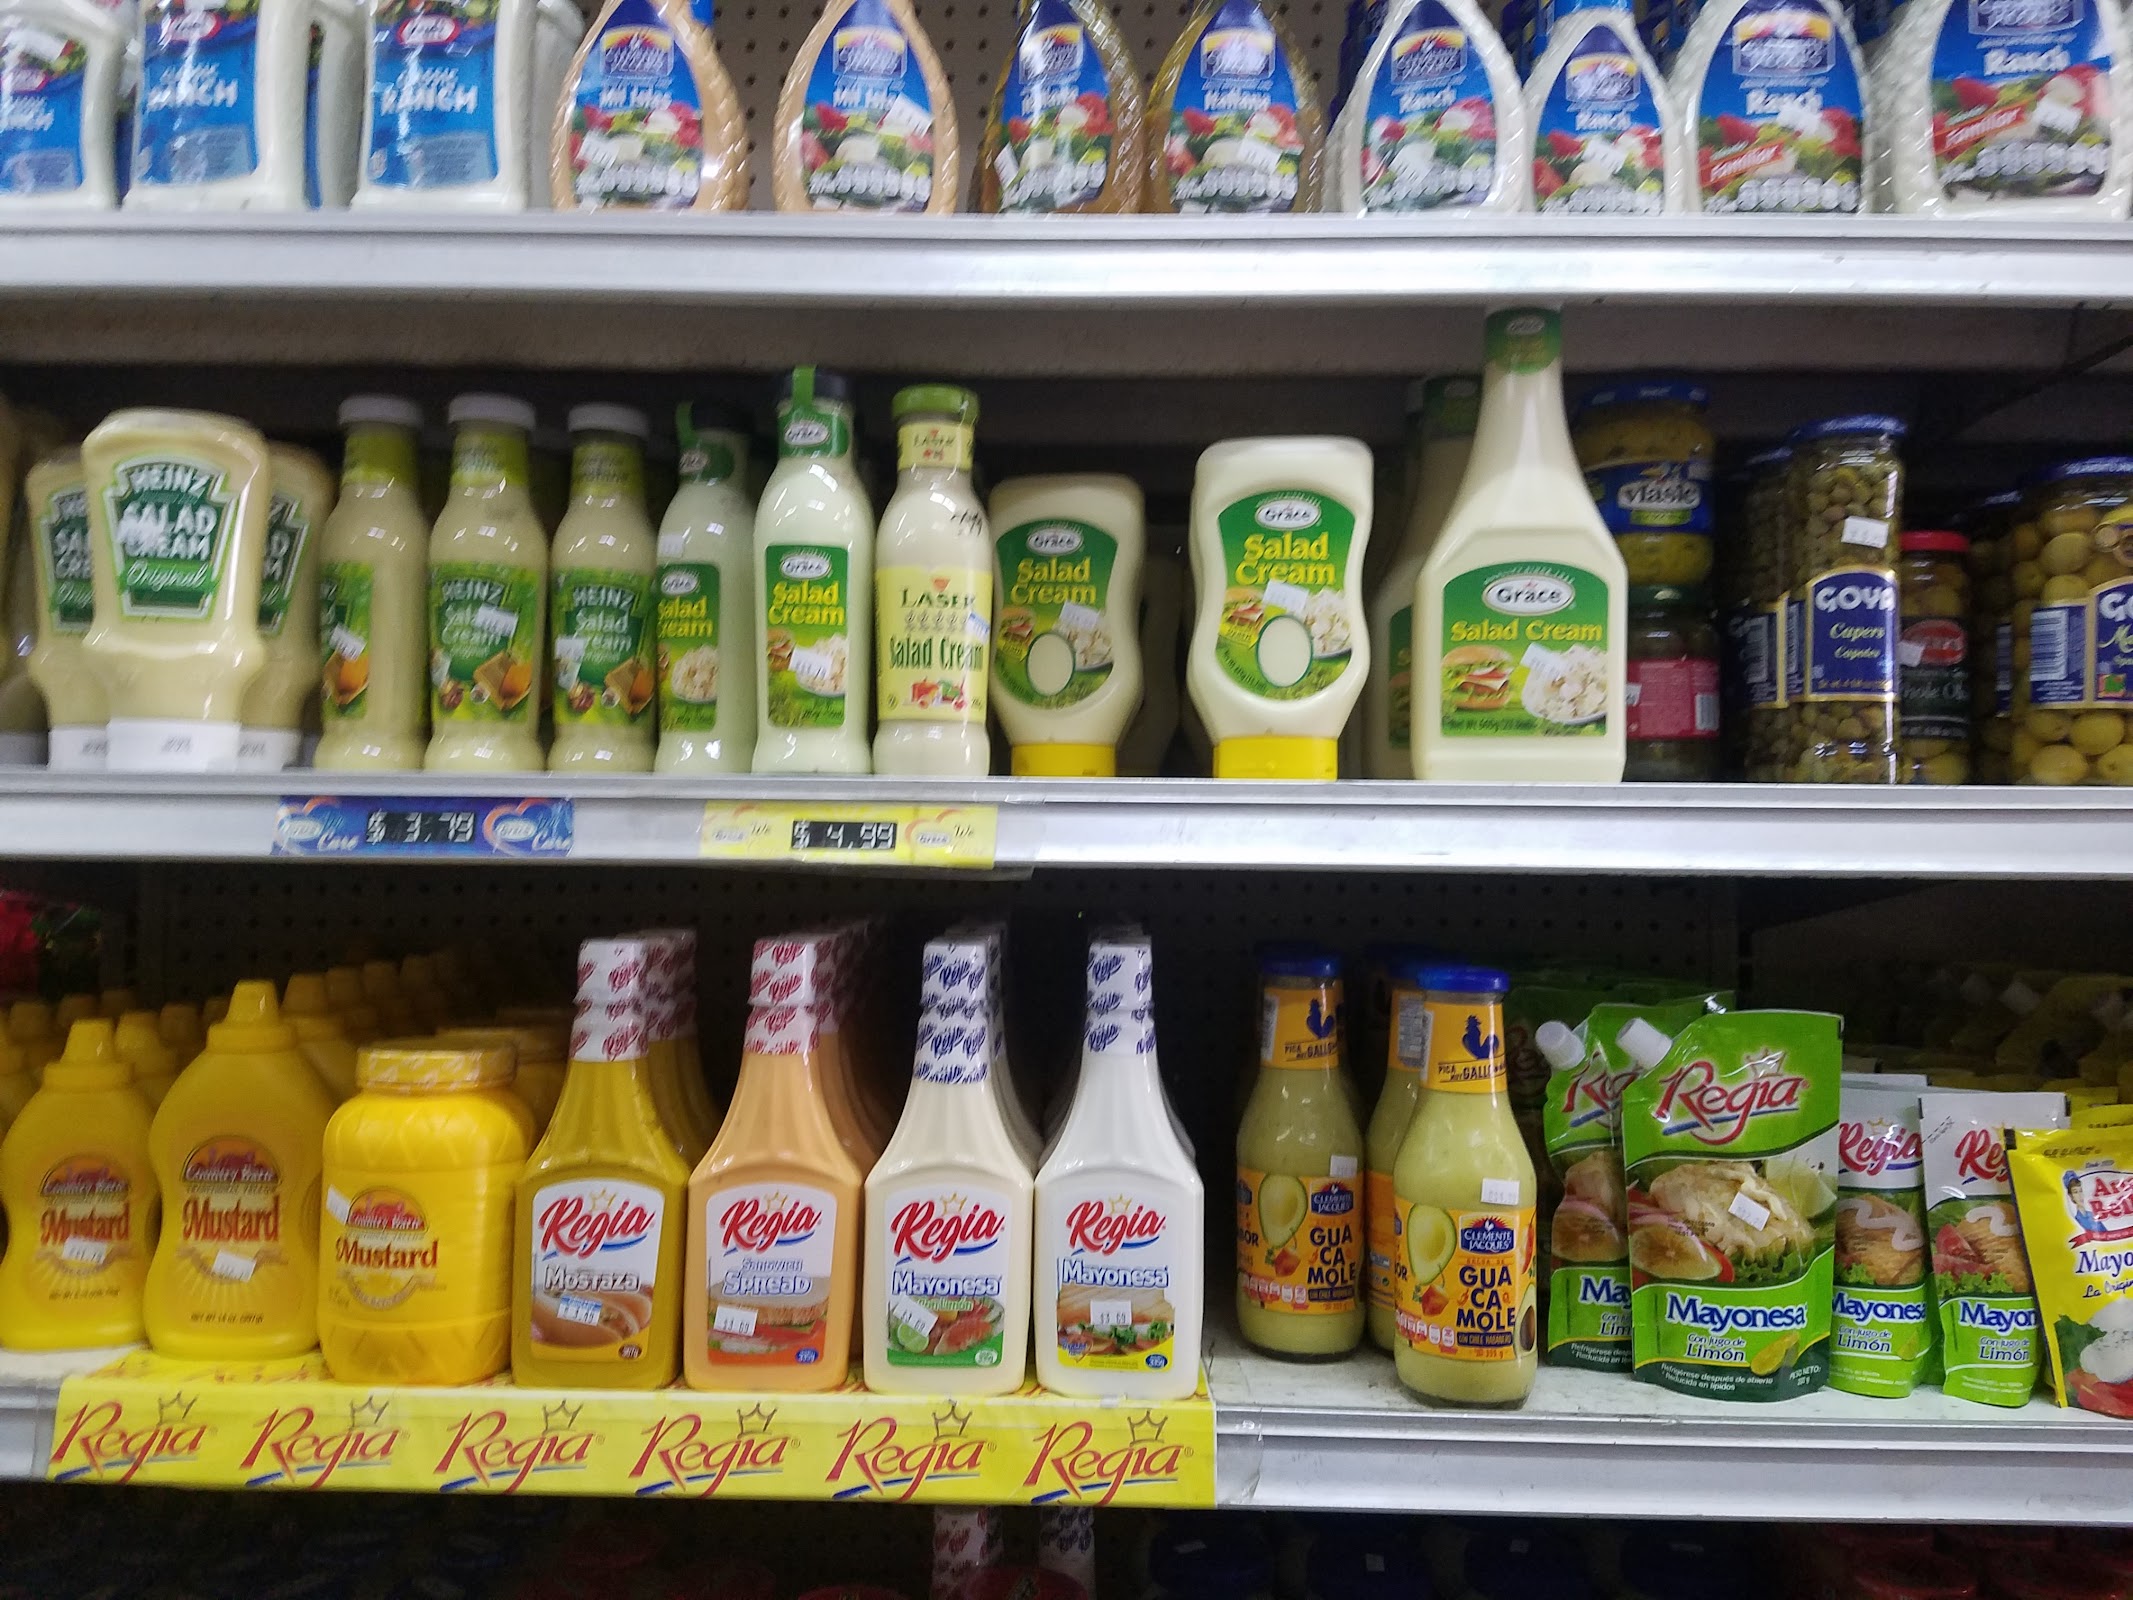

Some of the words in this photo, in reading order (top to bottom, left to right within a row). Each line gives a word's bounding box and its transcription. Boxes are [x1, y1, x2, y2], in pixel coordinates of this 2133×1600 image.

[130, 463, 209, 498] HEINZ
[1263, 508, 1311, 523] Grace
[1243, 531, 1328, 561] Salad
[1016, 556, 1090, 583] Salad
[1235, 561, 1335, 585] Cream
[442, 578, 504, 606] HEINZ
[573, 585, 634, 612] HEINZ
[772, 580, 839, 607] Salad
[1009, 583, 1096, 606] Cream
[1496, 587, 1562, 604] Grace
[575, 606, 629, 634] Salad
[768, 604, 846, 627] Cream
[1450, 618, 1519, 641] Salad
[1525, 619, 1603, 641] Cream
[889, 634, 933, 671] Salad
[940, 637, 984, 673] Cream
[826, 822, 893, 850] 4.99
[1652, 1060, 1804, 1145] Regia
[1840, 1122, 1922, 1177] Regia
[41, 1202, 130, 1245] Mustard
[183, 1193, 280, 1242] Mustard
[538, 1195, 656, 1260] Regia
[719, 1197, 822, 1254] Regia
[1065, 1200, 1166, 1256] Regia
[889, 1200, 1006, 1264] Regia
[1310, 1225, 1353, 1247] GUA
[1464, 1229, 1512, 1242] CLEMENTE
[336, 1238, 440, 1268] Mustard
[1319, 1247, 1346, 1266] CA
[1468, 1240, 1511, 1253] JACQUES
[892, 1269, 1002, 1298] Mayonesa
[1061, 1259, 1170, 1289] Mayonesa
[1307, 1262, 1356, 1287] MOLE
[1459, 1266, 1512, 1289] GUA
[1471, 1288, 1502, 1310] CA
[1666, 1294, 1806, 1332] Mayonesa
[1456, 1307, 1516, 1331] MOLE
[1686, 1343, 1745, 1362] Limón
[1688, 1333, 1707, 1344] Con
[1732, 1338, 1746, 1347] de
[1837, 1334, 1891, 1352] Limón
[1979, 1346, 2030, 1361] Limón
[51, 1402, 205, 1484] Regia
[240, 1408, 398, 1491] Regia
[434, 1411, 593, 1494] Regia
[628, 1414, 791, 1500] Regia
[825, 1417, 986, 1502] Regia
[1023, 1421, 1183, 1505] Regia
